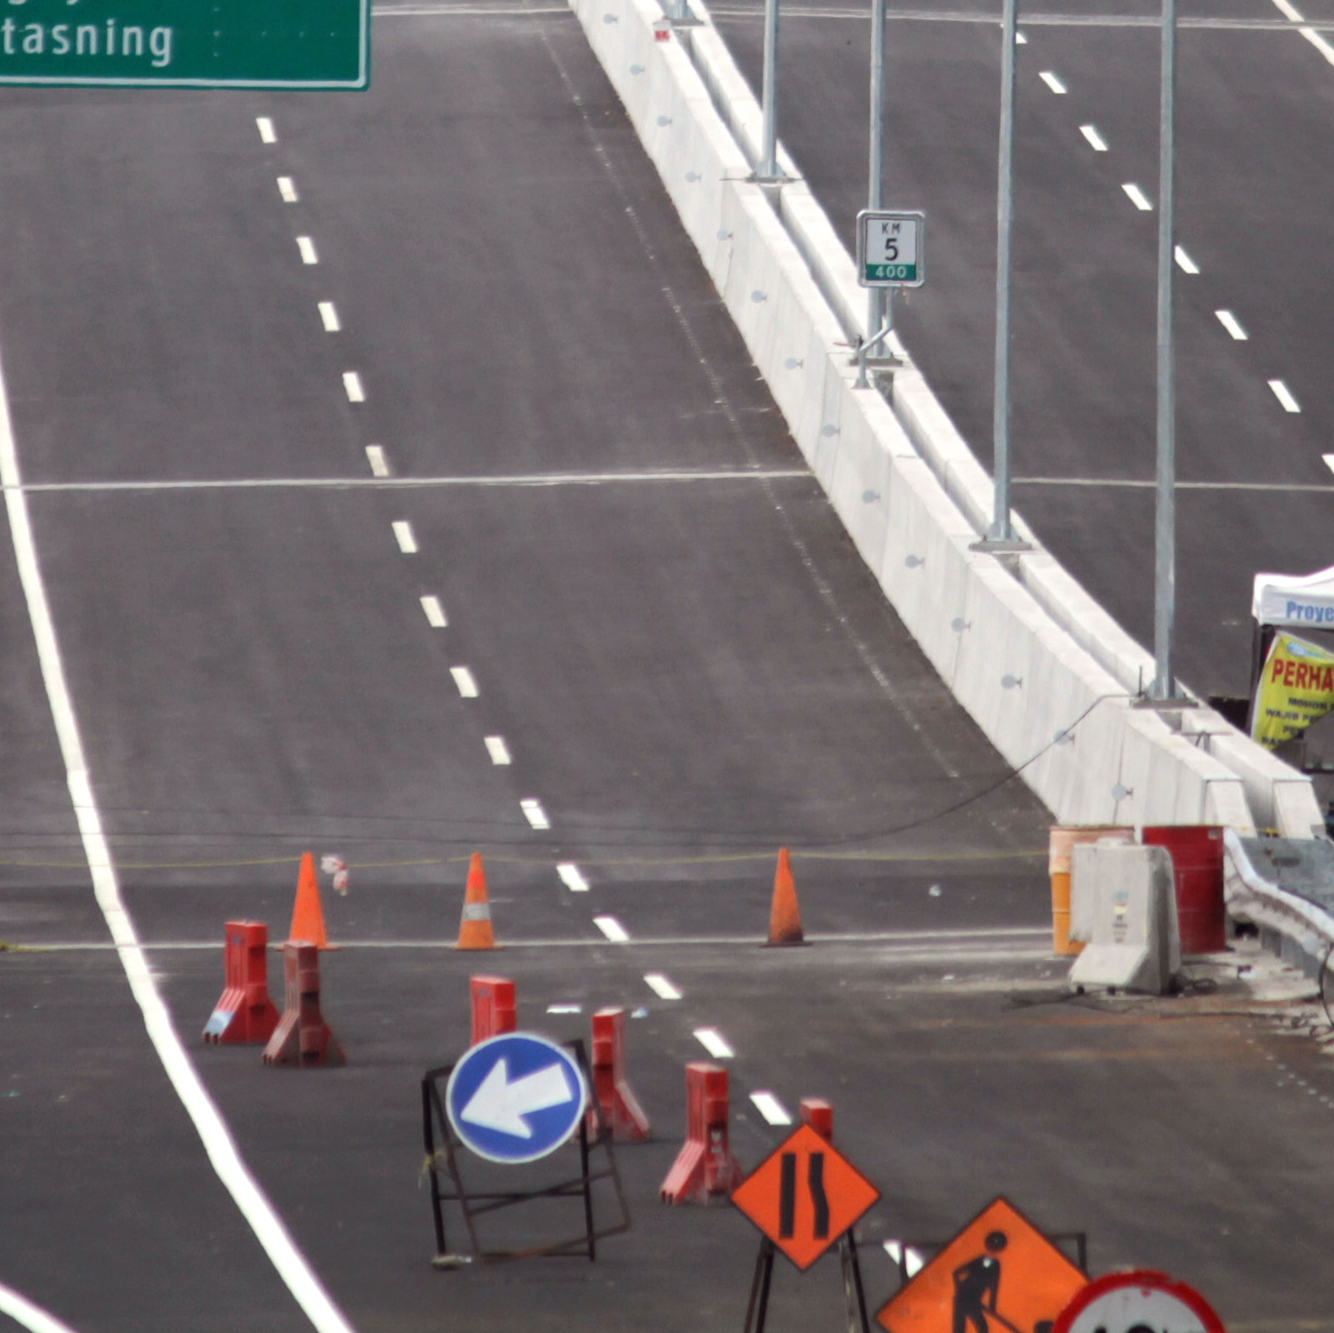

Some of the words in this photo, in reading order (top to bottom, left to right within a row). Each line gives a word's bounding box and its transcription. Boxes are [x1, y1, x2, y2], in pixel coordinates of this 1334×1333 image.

[882, 223, 900, 234] KM
[885, 238, 898, 261] 5
[875, 266, 906, 278] 400
